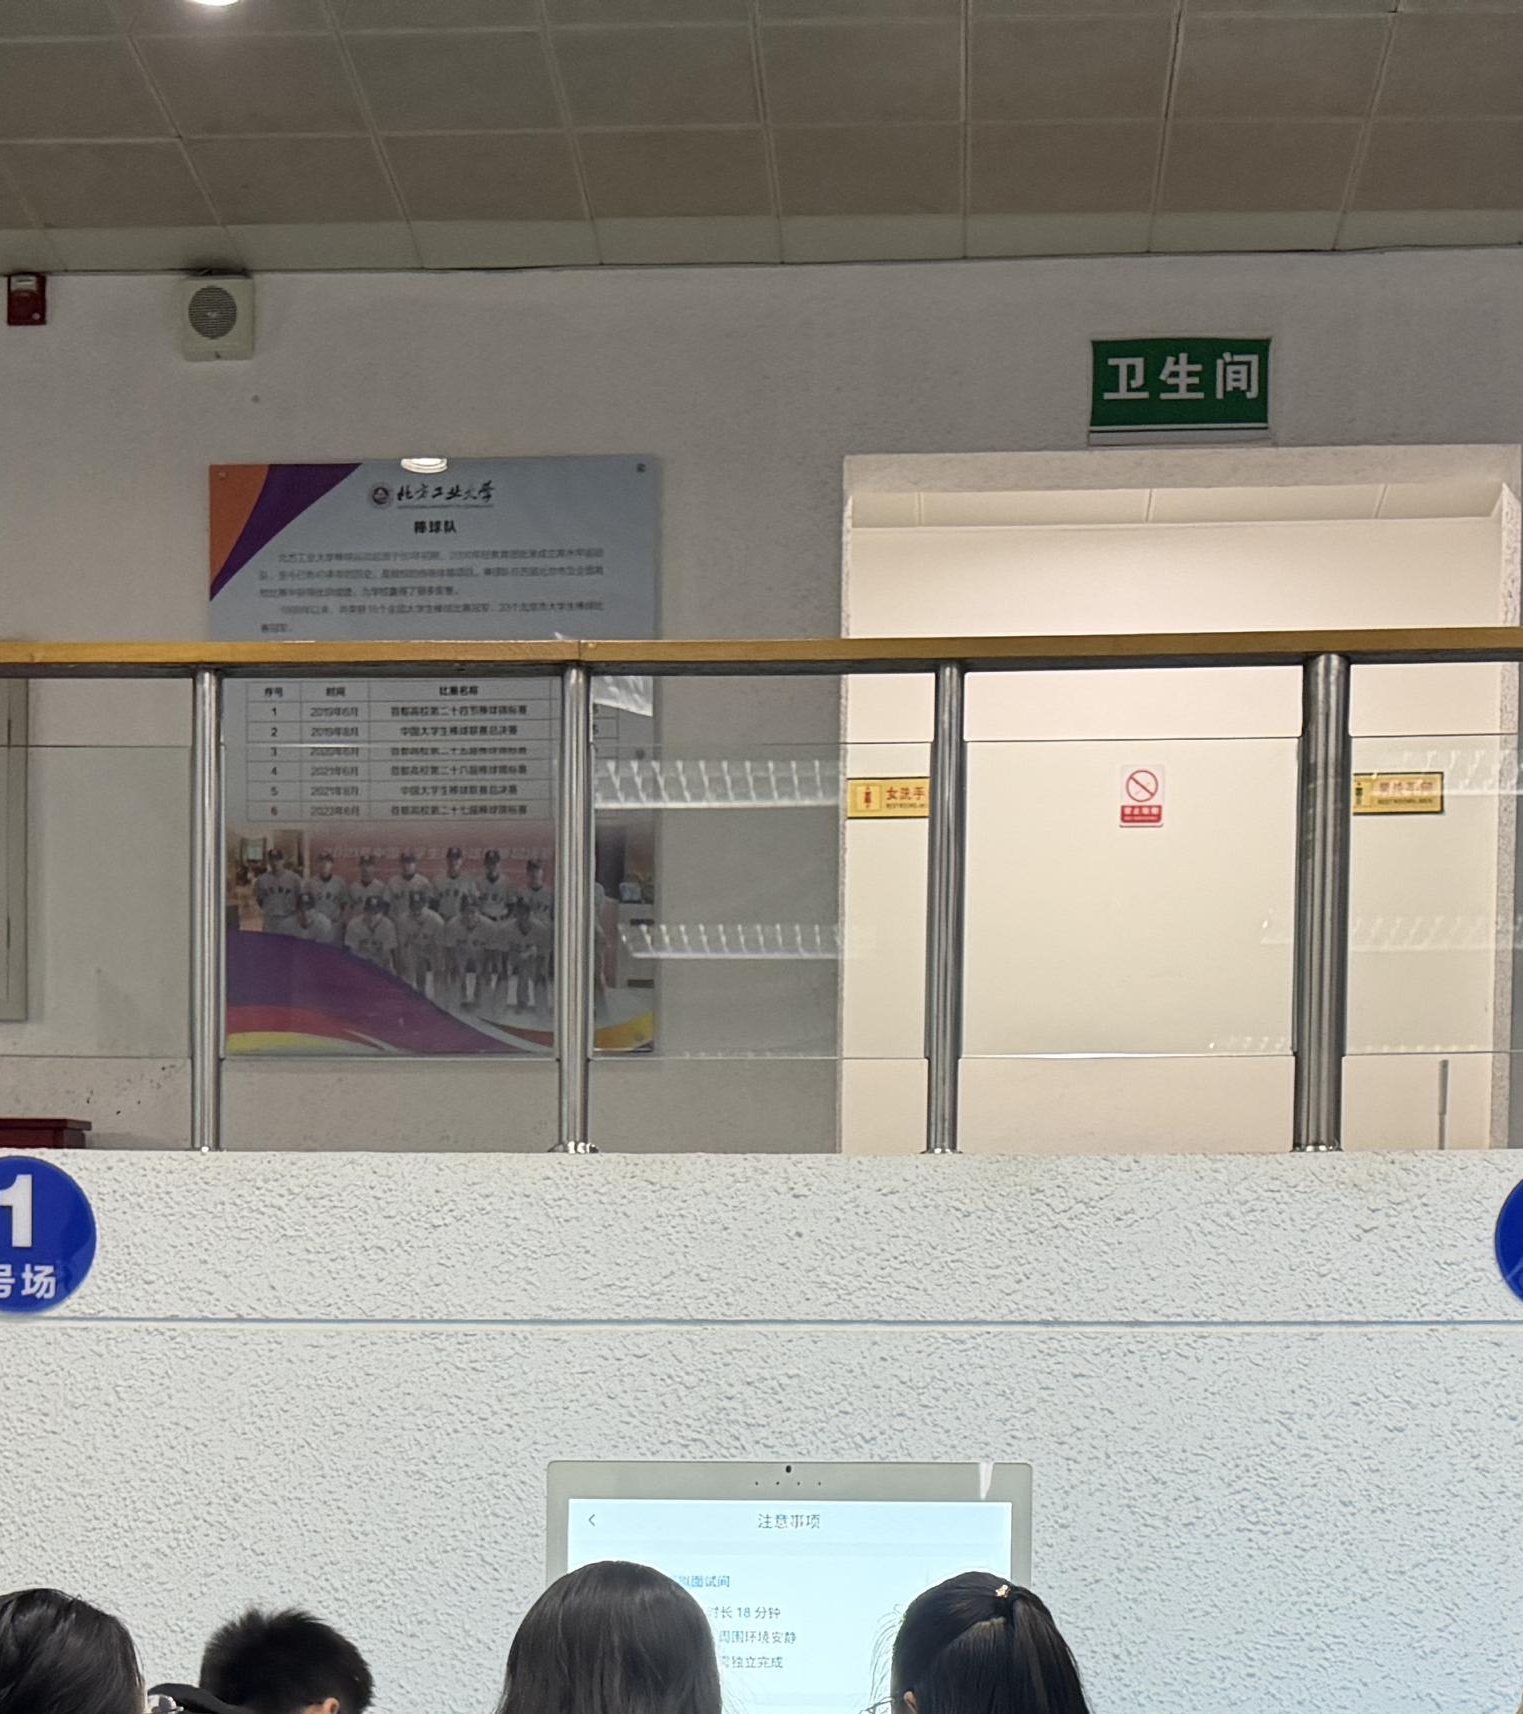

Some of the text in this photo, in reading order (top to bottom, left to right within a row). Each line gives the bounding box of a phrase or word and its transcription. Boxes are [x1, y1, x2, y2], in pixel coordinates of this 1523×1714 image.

[1103, 352, 1259, 400] 卫生间
[396, 480, 496, 503] 北方工业大学
[414, 520, 457, 534] 棒球队
[757, 1514, 821, 1529] 注意事项
[738, 1607, 751, 1618] 18
[754, 1606, 781, 1619] 分钟
